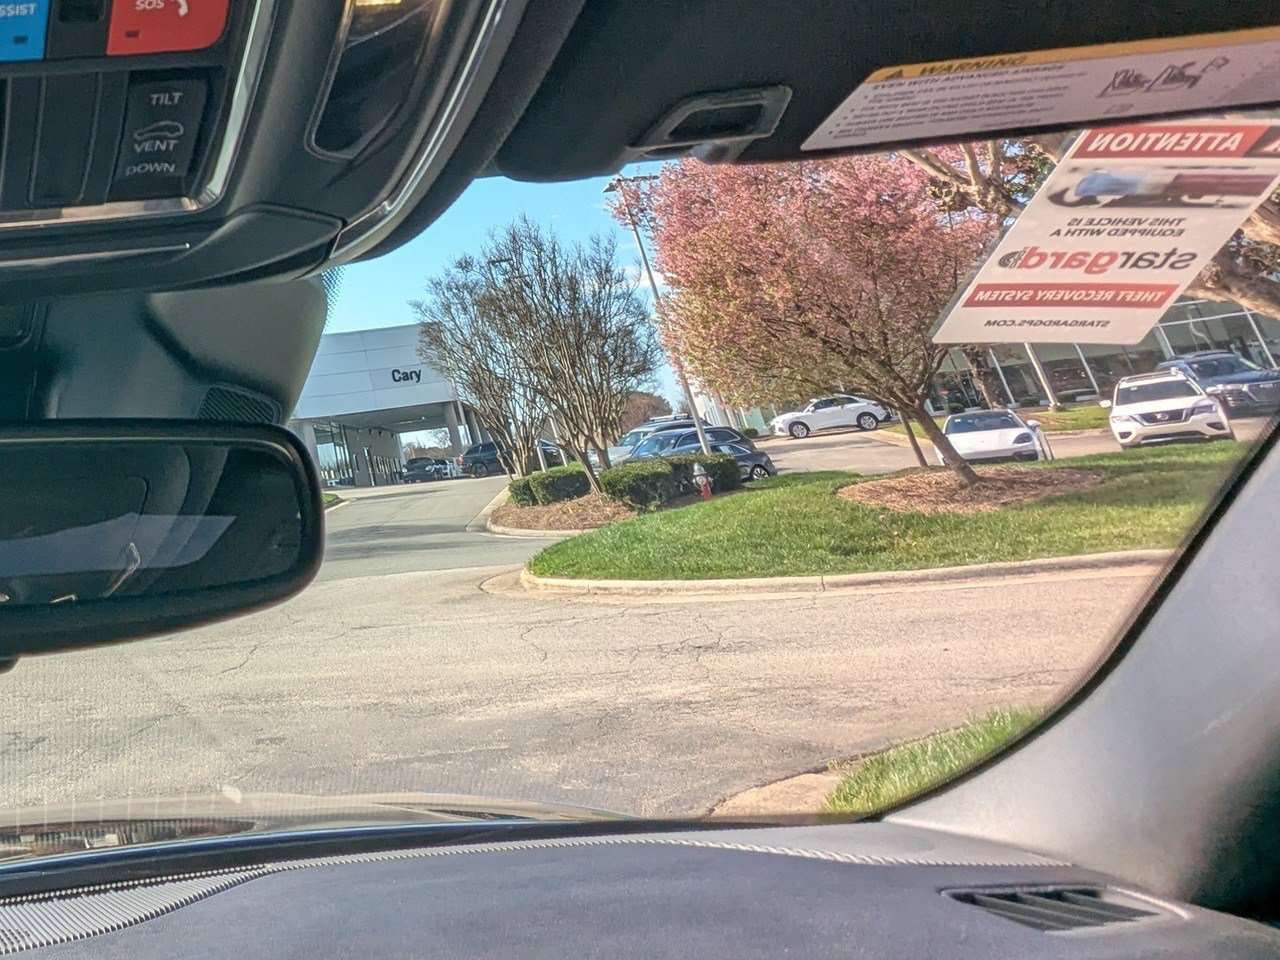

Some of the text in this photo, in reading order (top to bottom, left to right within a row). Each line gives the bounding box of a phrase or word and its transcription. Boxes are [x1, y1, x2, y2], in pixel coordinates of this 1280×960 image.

[150, 92, 183, 106] TILT
[133, 140, 179, 153] VENT
[125, 162, 176, 176] DOWN
[391, 368, 422, 383] Cary
